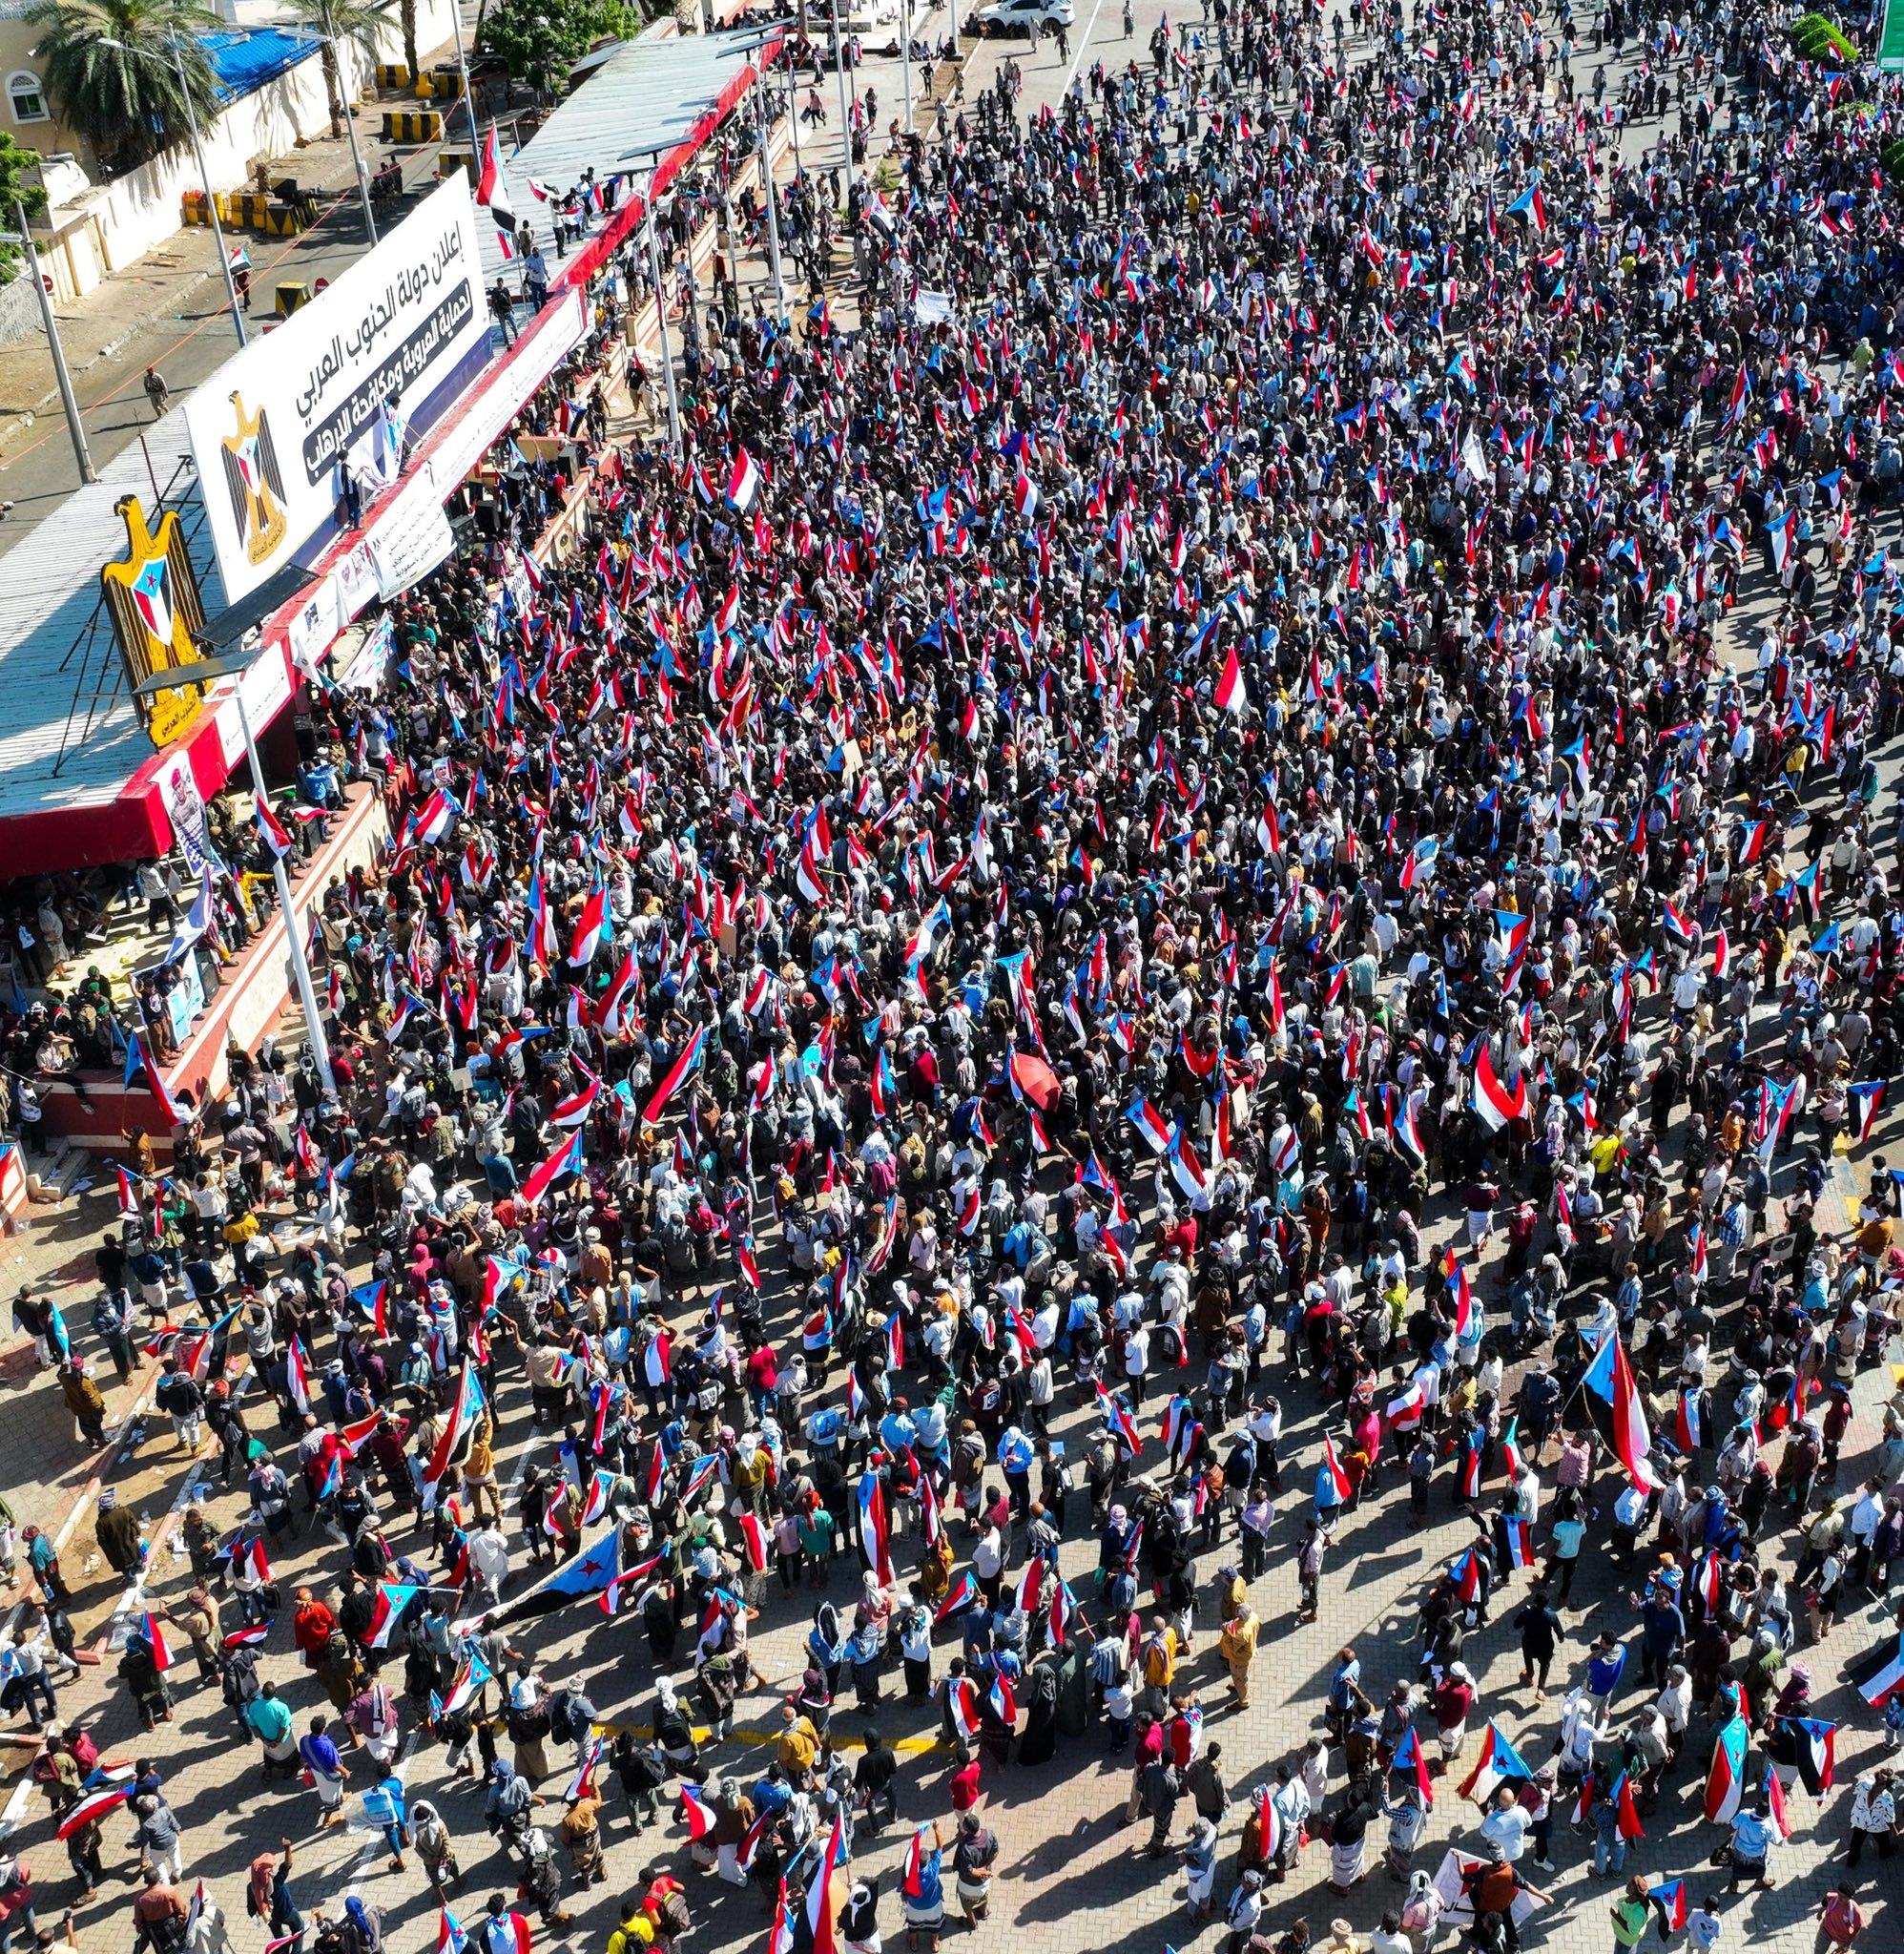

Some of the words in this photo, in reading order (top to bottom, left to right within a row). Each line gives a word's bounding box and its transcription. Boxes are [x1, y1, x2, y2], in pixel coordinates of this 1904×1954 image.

[431, 220, 465, 284] إعلان
[398, 262, 429, 307] دولة
[438, 283, 472, 338] لحماية
[346, 285, 397, 365] الجنوب
[403, 318, 440, 375] العروبة
[296, 335, 343, 427] العربي
[351, 362, 404, 426] ومكافحة
[306, 407, 352, 477] الإرهاب
